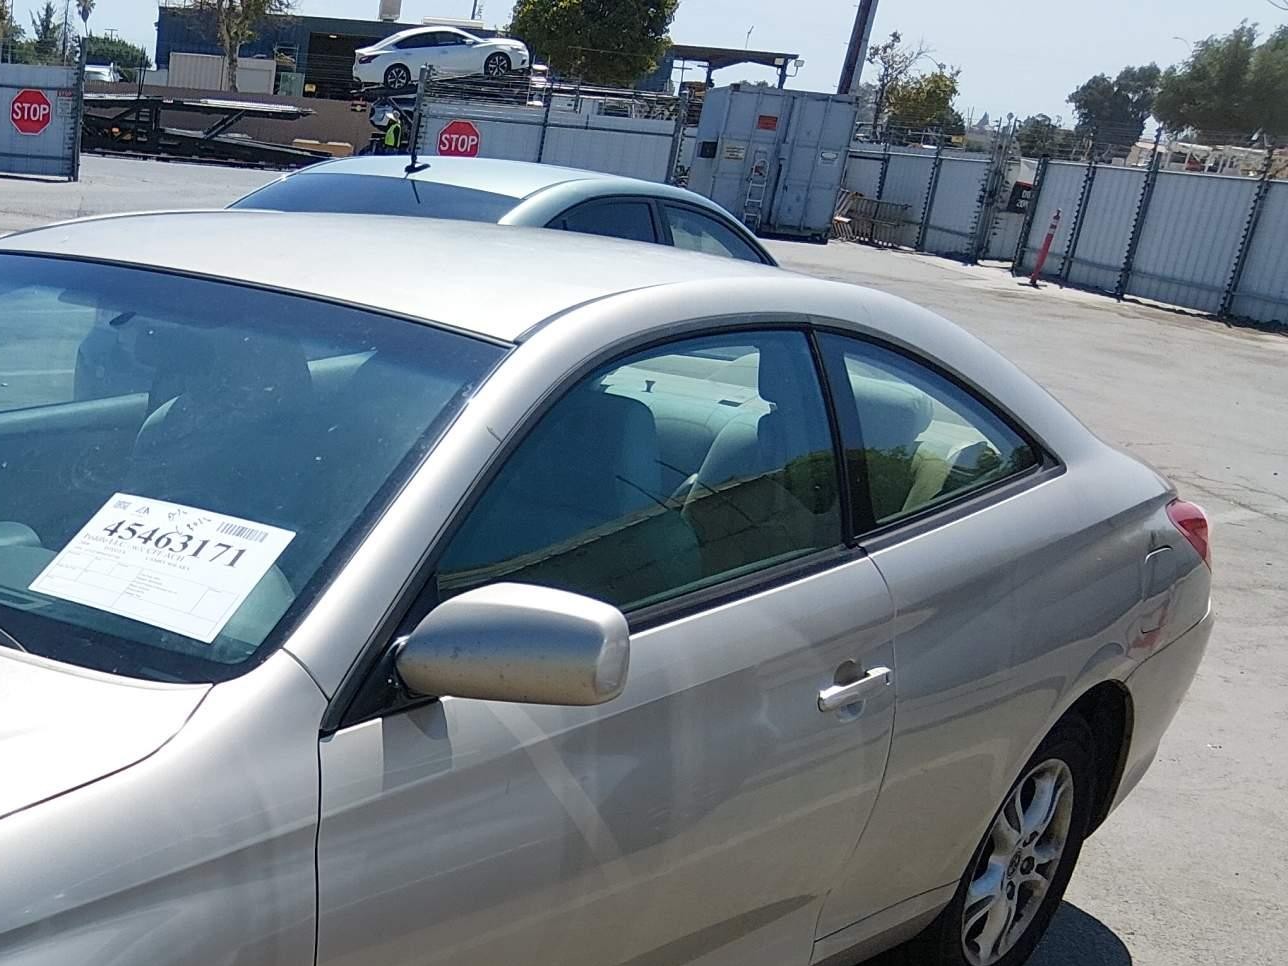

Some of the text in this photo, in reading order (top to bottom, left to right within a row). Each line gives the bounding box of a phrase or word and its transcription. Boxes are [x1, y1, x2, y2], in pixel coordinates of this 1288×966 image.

[13, 102, 49, 121] STOP
[440, 134, 478, 152] STOP
[103, 519, 247, 567] 45463171
